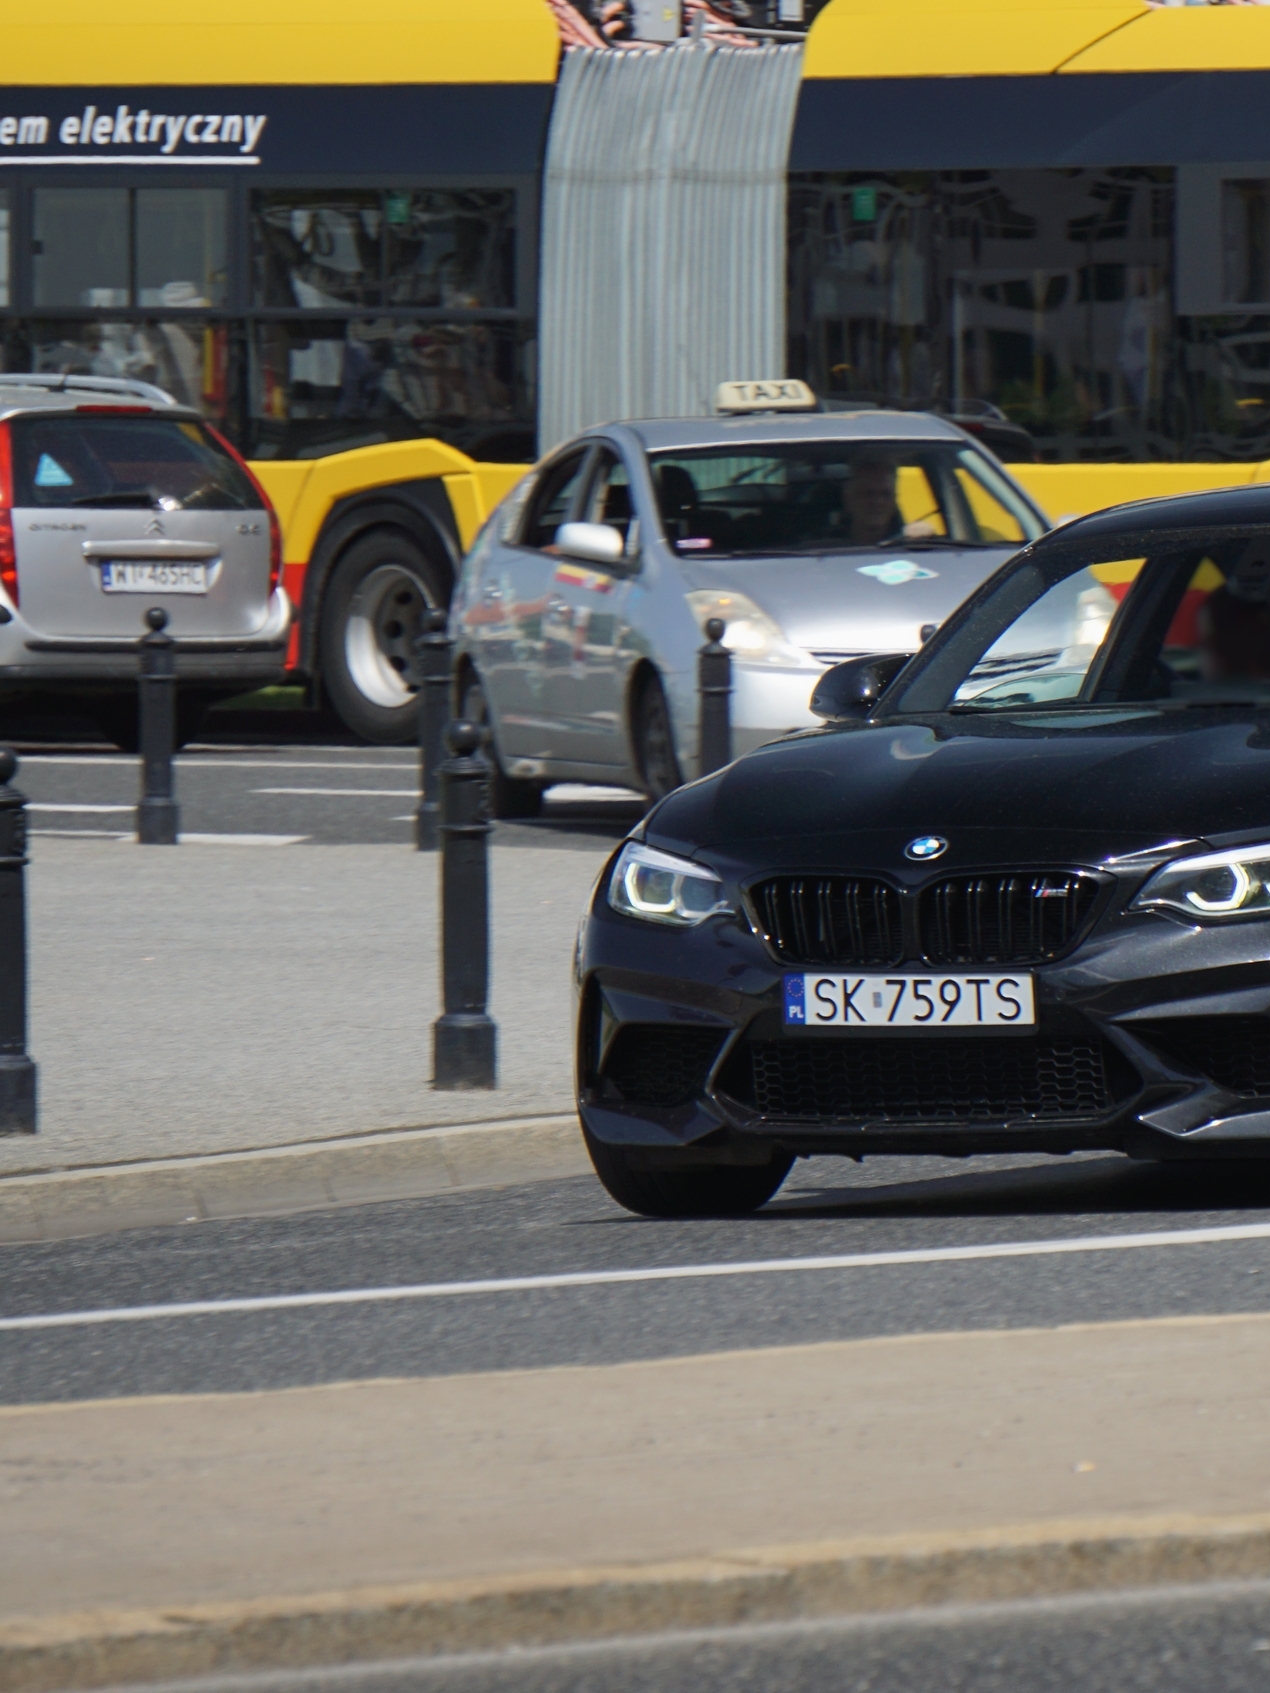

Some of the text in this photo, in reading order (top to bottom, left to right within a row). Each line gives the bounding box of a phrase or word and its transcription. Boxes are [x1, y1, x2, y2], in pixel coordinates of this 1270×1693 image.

[59, 105, 267, 154] elektryczny
[731, 383, 803, 401] TAXI
[789, 1006, 804, 1018] PL
[814, 978, 1021, 1022] SK 759TS
